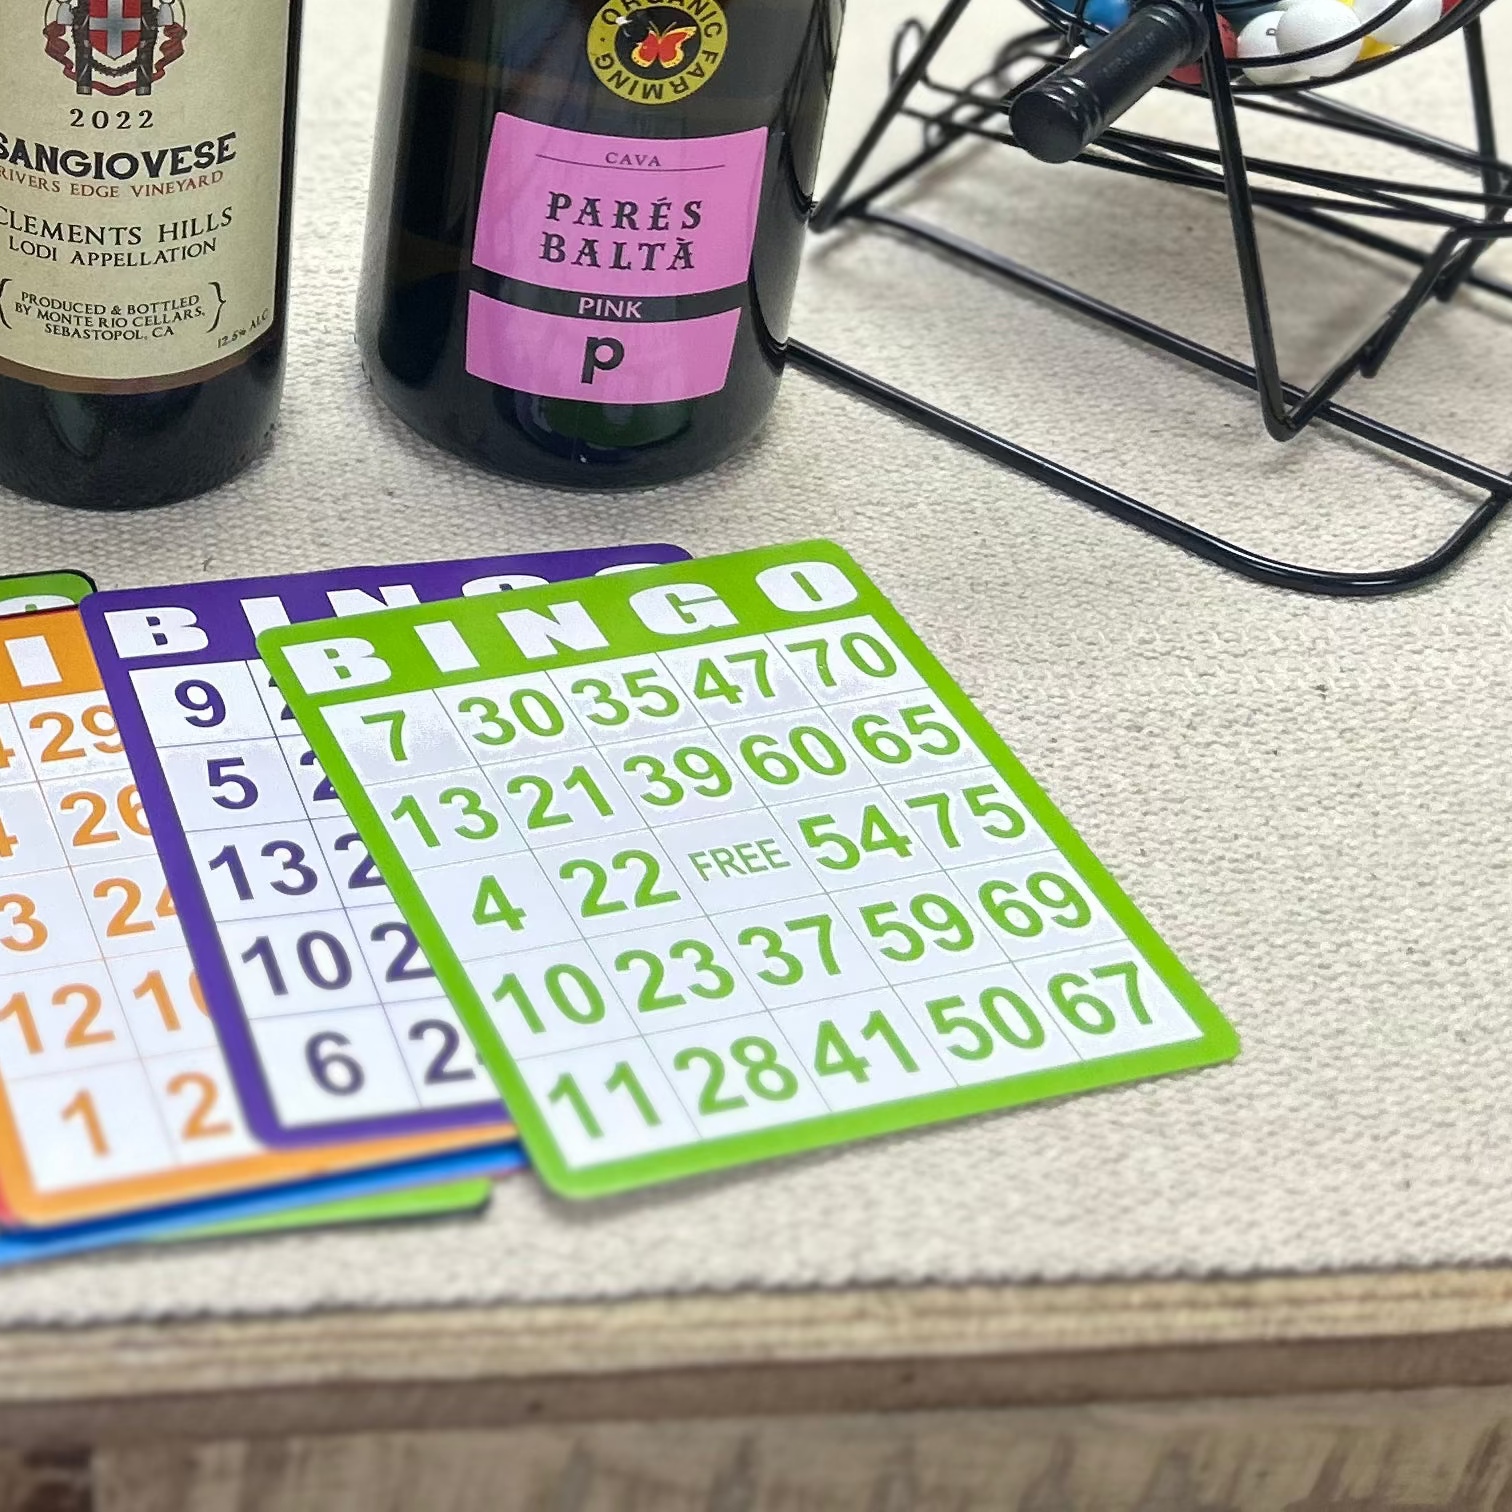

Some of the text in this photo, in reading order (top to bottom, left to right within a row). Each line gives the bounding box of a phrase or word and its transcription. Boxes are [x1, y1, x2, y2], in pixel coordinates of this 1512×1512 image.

[593, 49, 719, 101] FARMING
[69, 108, 154, 129] 2022
[70, 182, 119, 198] EDGE
[131, 170, 224, 197] VINEYARD
[605, 151, 662, 168] CAVA
[158, 206, 233, 244] HILLS
[546, 191, 703, 231] PARÉS
[9, 236, 217, 268] LODI APPELLATION
[539, 231, 695, 272] BALTÀ
[15, 301, 32, 316] BY
[36, 308, 95, 328] MONTE
[98, 315, 129, 328] RIO
[21, 291, 200, 316] PRODUCED & BOTTLED
[249, 307, 269, 331] ALC
[578, 296, 642, 319] PINK
[151, 326, 175, 338] CA
[581, 336, 625, 384] p
[173, 678, 227, 728] 9
[361, 631, 898, 762] 7 30 35 47 70
[29, 704, 124, 763] 29
[206, 756, 259, 810] 5
[391, 704, 961, 848] 13 21 39 60 65
[59, 783, 152, 847] 26
[208, 840, 318, 901] 13
[472, 782, 1026, 932] 4 22 FREE 54 75
[241, 930, 353, 996] 10
[493, 870, 1093, 1034] 10 23 37 59 69
[303, 1031, 365, 1096] 6
[548, 960, 1157, 1139] 11 28 41 50 67
[61, 1089, 110, 1157] 1
